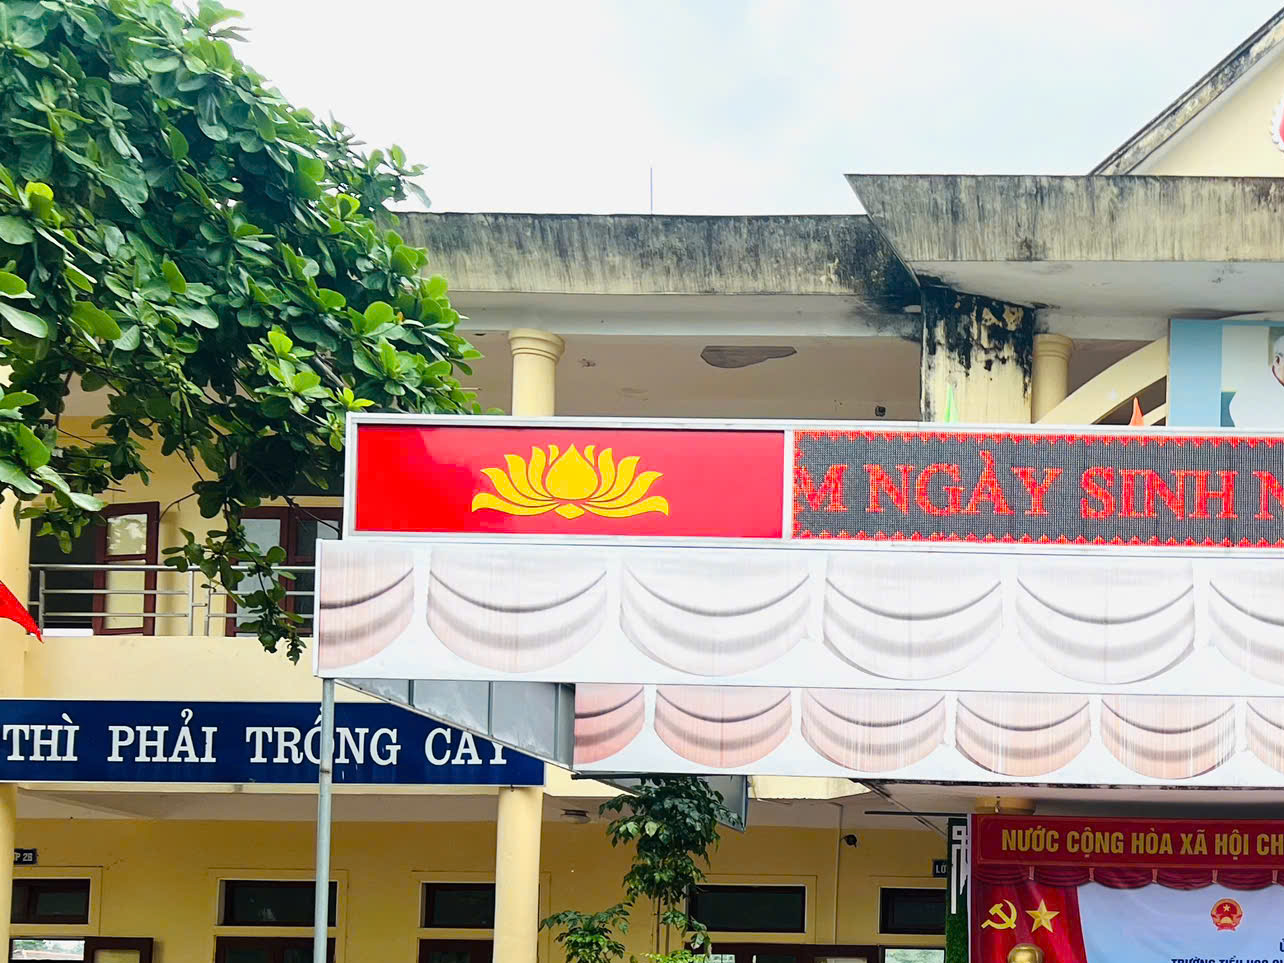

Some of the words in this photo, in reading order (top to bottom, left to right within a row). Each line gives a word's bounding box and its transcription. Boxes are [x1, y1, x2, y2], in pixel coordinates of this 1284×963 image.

[863, 450, 1063, 516] NGÀY
[1080, 466, 1239, 520] SINH
[2, 712, 80, 762] THÌ
[107, 708, 218, 763] PHẢI
[1001, 825, 1059, 852] NƯỚC
[1066, 826, 1124, 858] CỘNG
[1131, 828, 1174, 855] HÒA
[1180, 829, 1208, 855] XÃ
[1215, 829, 1249, 861] HỘI
